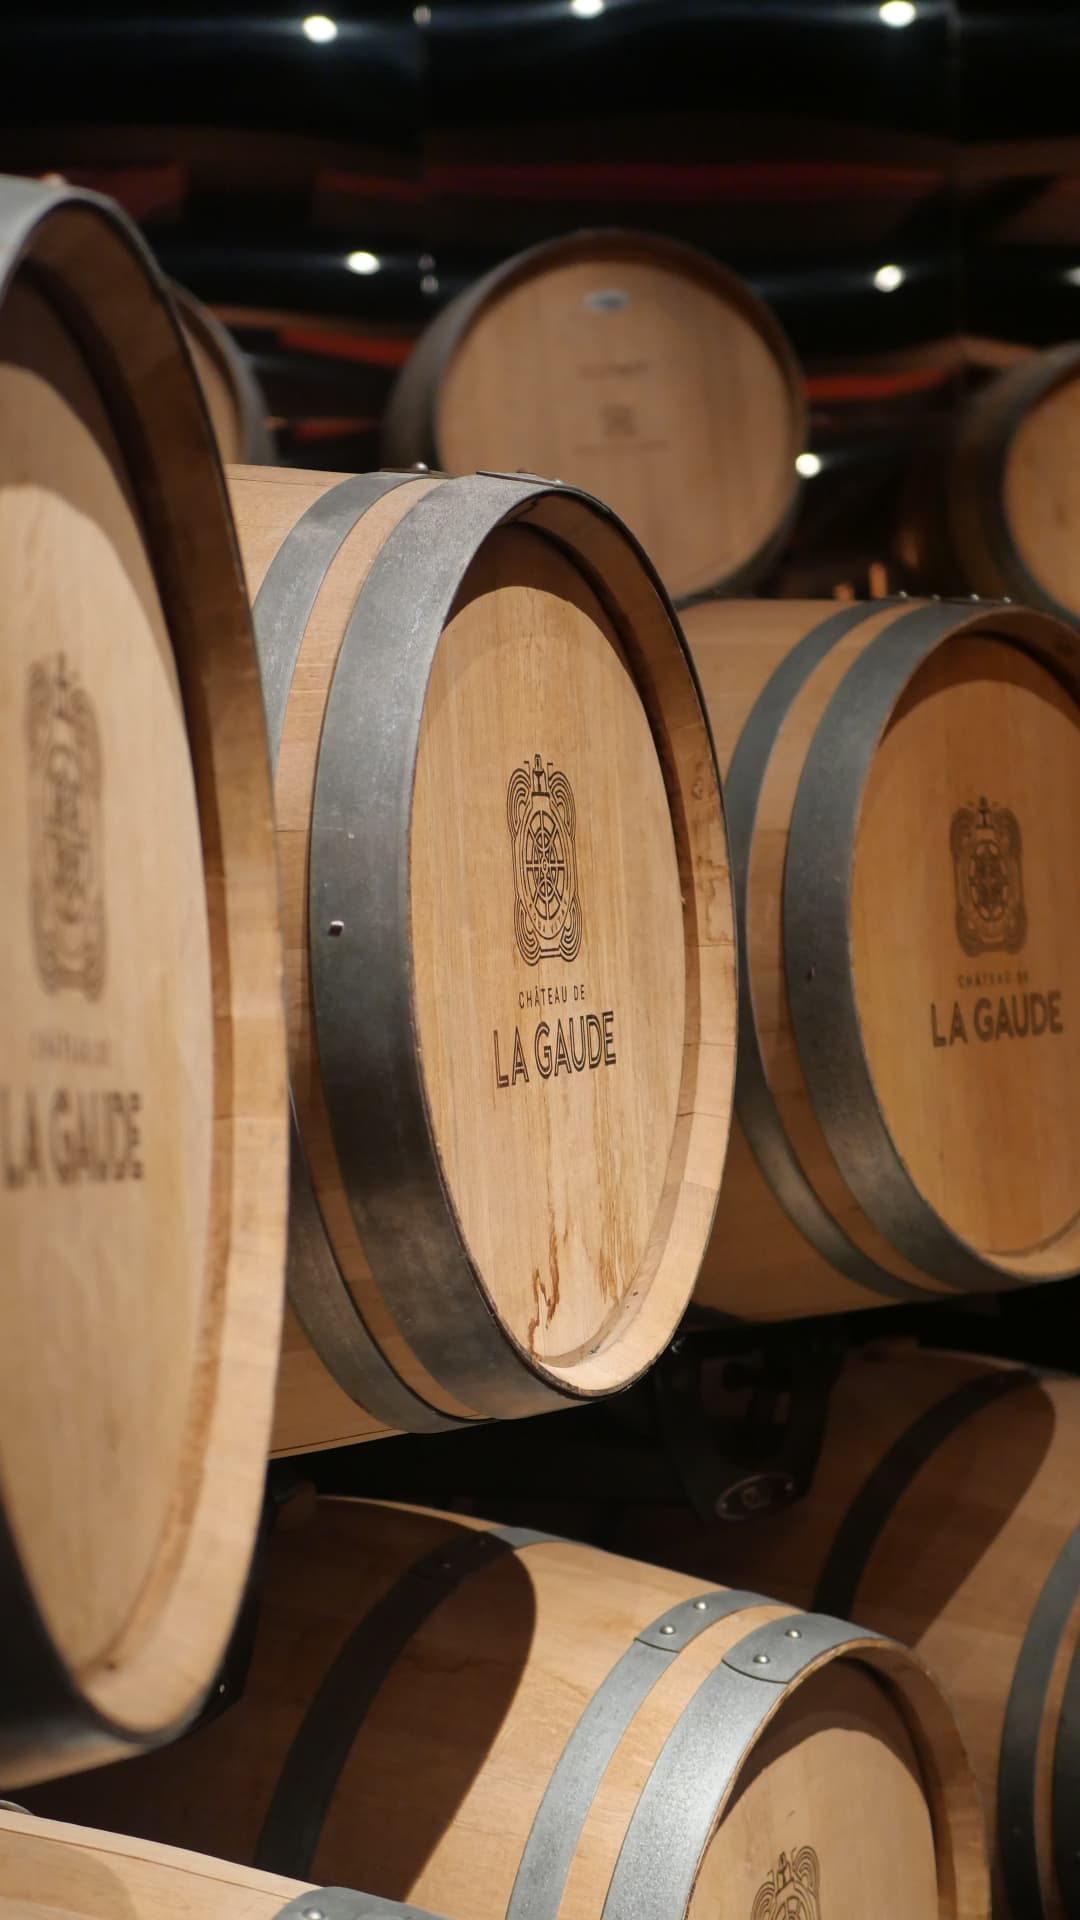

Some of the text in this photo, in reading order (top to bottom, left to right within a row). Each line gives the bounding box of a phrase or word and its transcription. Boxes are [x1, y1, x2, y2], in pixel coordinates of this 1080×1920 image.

[518, 984, 585, 1008] CHÂTEAU DE
[930, 990, 1064, 1047] LA GAUDE
[493, 1010, 616, 1088] LA GAUDE
